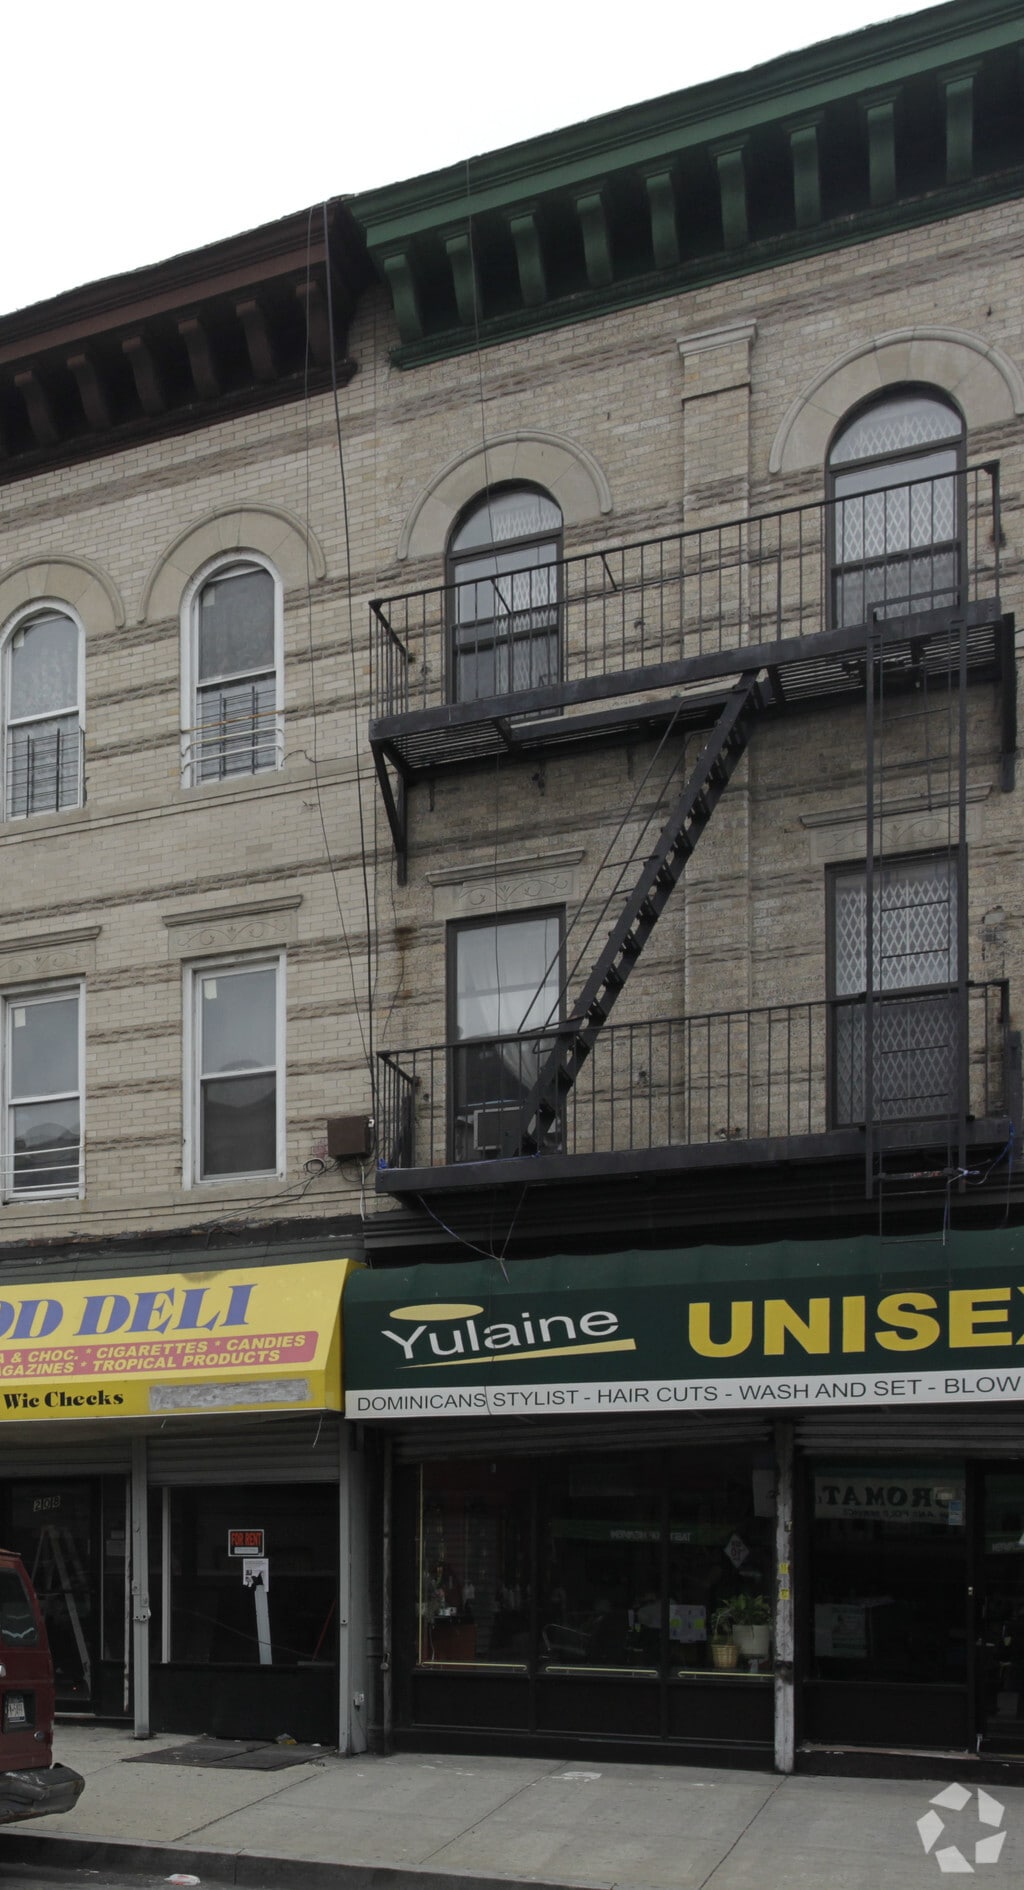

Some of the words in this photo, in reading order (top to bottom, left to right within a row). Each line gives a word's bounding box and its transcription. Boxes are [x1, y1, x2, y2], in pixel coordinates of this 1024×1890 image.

[72, 1283, 259, 1338] DELI
[688, 1287, 1024, 1358] UNISE
[10, 1352, 23, 1364] &
[28, 1348, 79, 1363] CHOC.
[95, 1340, 209, 1359] CIGARETTES
[226, 1333, 307, 1352] CANDIES
[381, 1310, 619, 1360] Yulaine
[92, 1355, 177, 1373] TROPICAL
[182, 1349, 281, 1368] PRODUCTS
[3, 1392, 41, 1410] Wic
[44, 1390, 125, 1408] Checks
[357, 1391, 487, 1412] DOMINICANS
[492, 1389, 580, 1407] STYLIST
[597, 1386, 650, 1404] HAIR
[656, 1385, 719, 1403] CUTS
[739, 1383, 809, 1401] WASH
[815, 1381, 867, 1399] AND
[873, 1379, 923, 1396] SET
[943, 1375, 1023, 1394] BLOW
[231, 1532, 244, 1546] FOR
[245, 1532, 262, 1546] RENT
